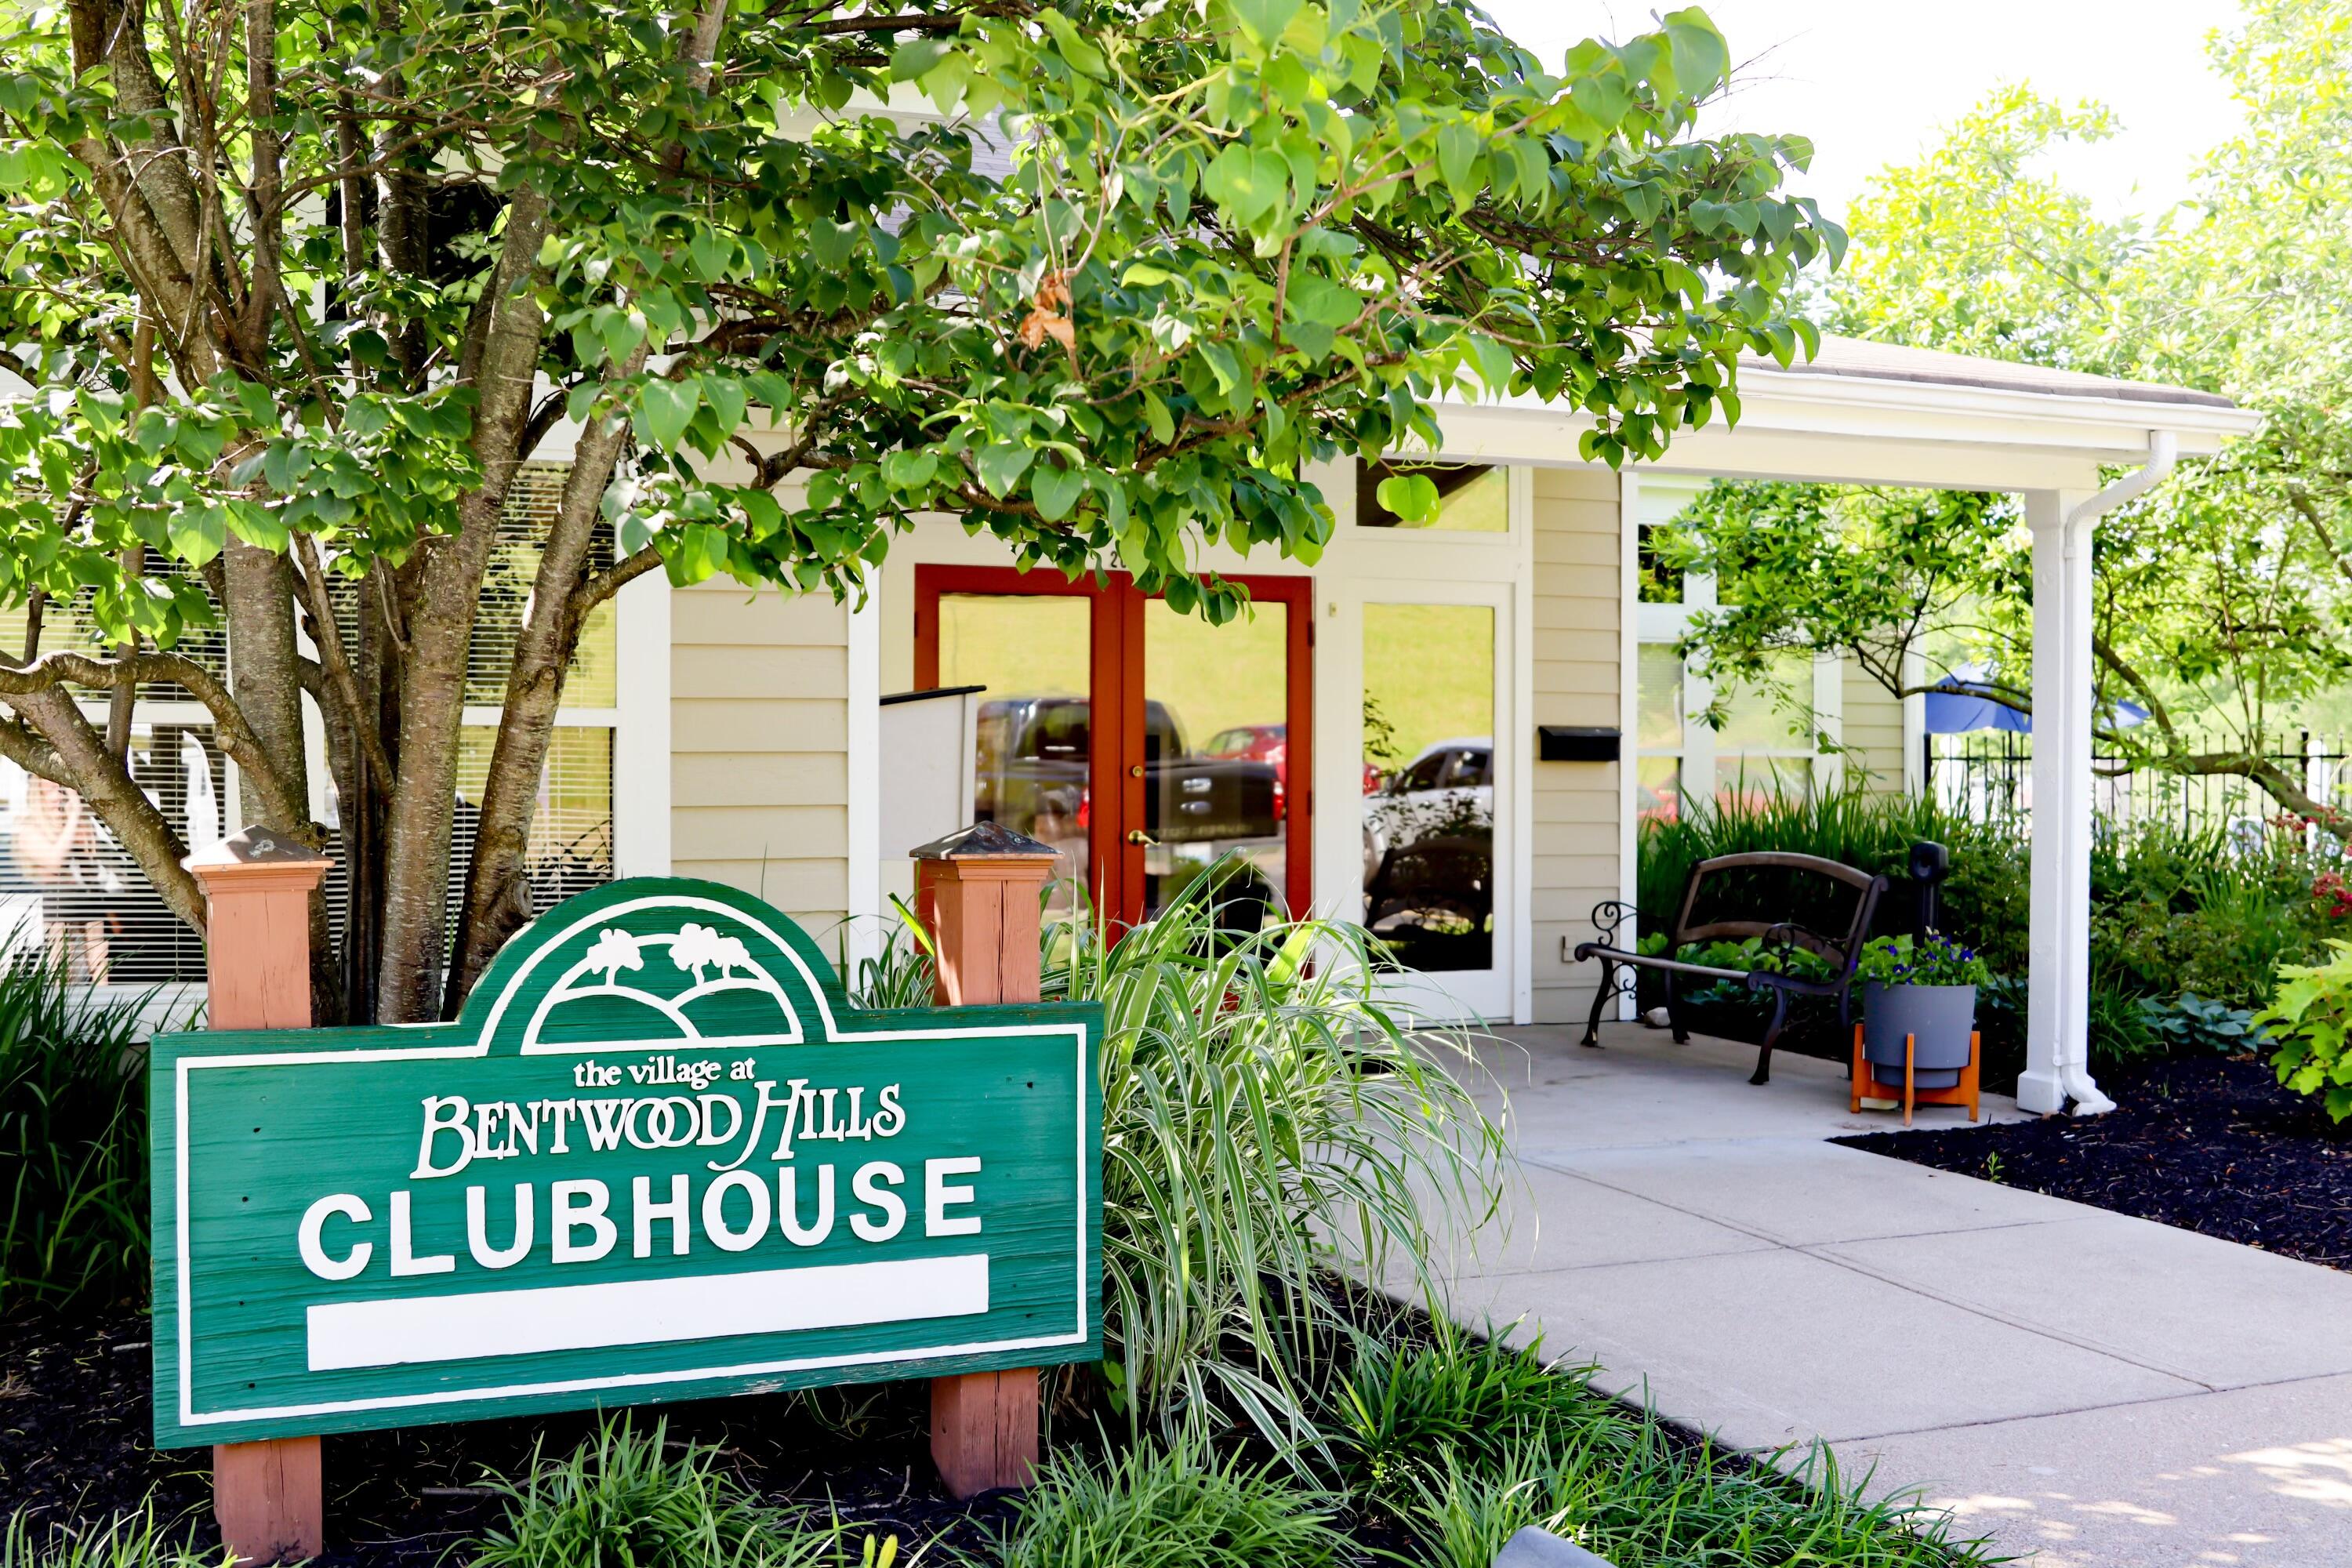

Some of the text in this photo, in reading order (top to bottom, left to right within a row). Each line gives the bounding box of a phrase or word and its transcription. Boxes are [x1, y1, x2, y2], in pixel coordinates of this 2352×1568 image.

[572, 1055, 756, 1091] the village at
[409, 1078, 906, 1179] BENTWOOD HILLS
[298, 1156, 982, 1281] CLUBHOUSE
